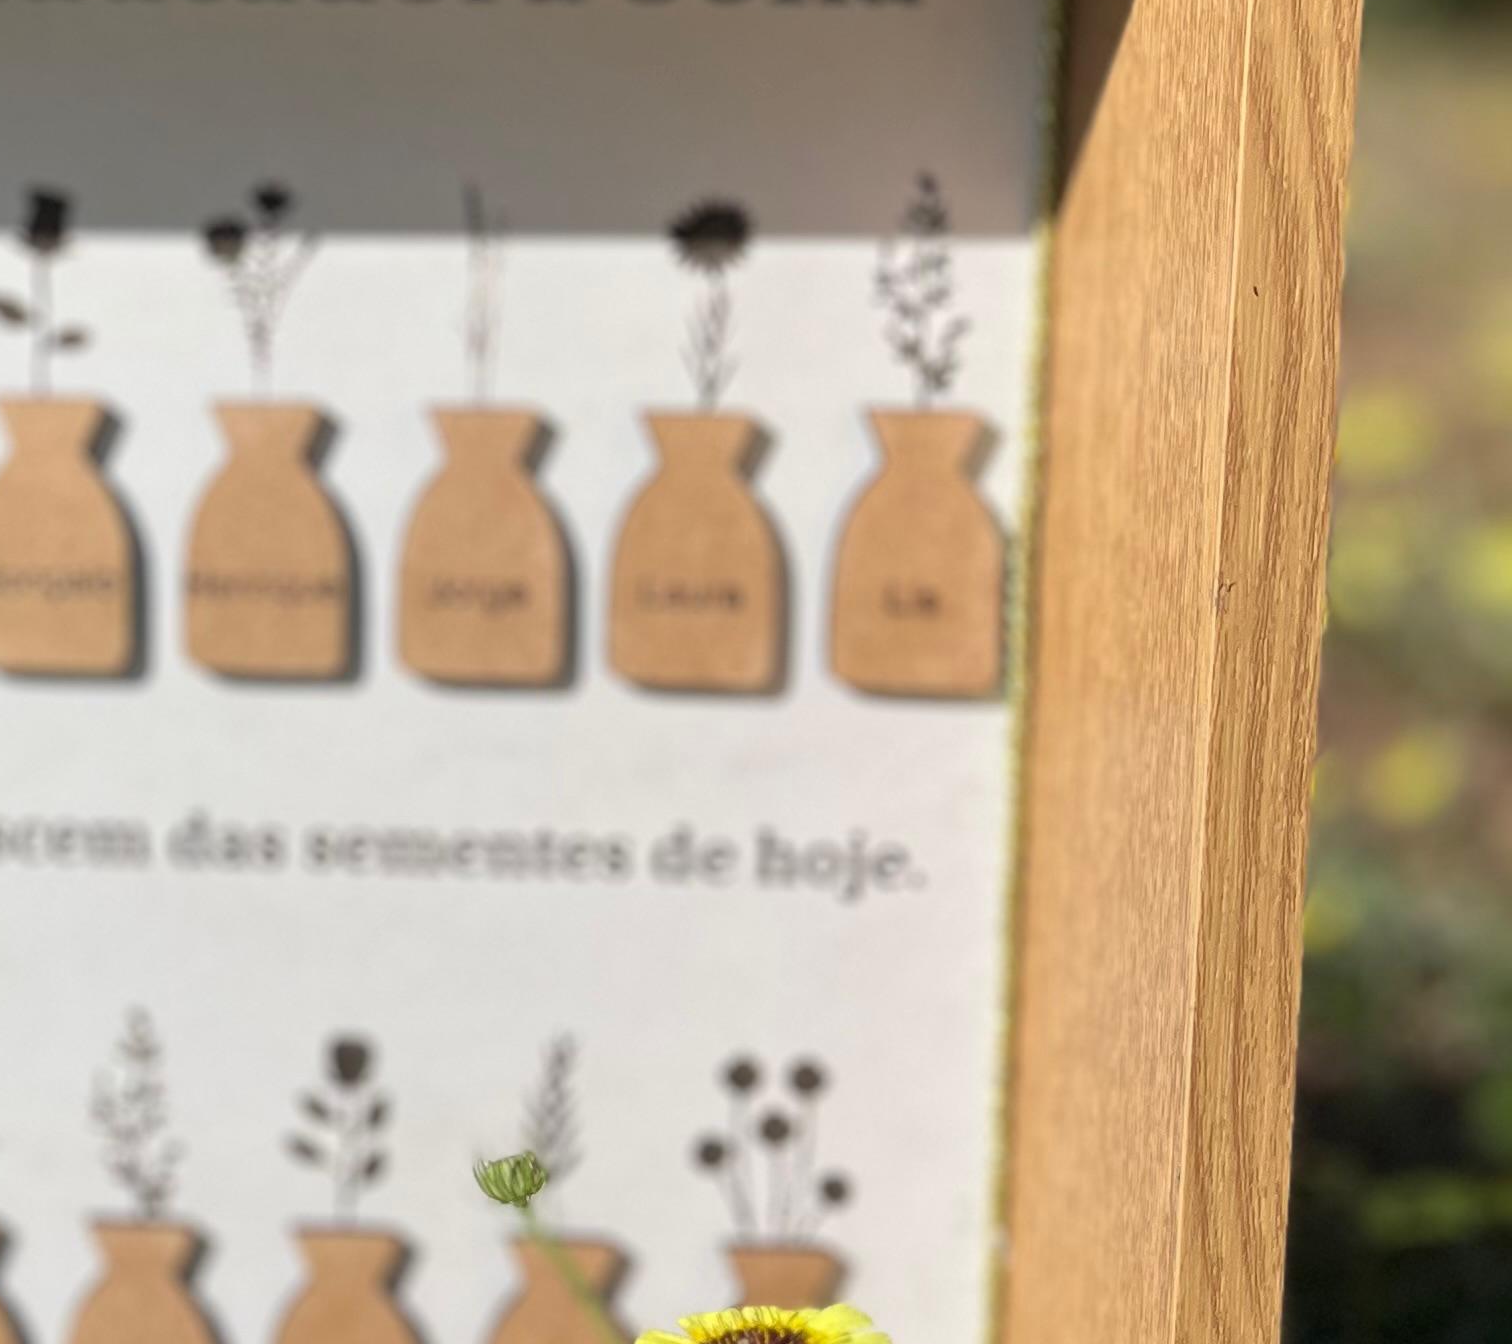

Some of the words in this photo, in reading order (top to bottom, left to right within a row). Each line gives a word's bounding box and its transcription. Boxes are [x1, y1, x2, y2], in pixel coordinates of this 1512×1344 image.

[168, 808, 284, 869] das
[305, 824, 630, 882] sementes
[650, 824, 738, 888] de
[754, 828, 926, 904] hoje.
